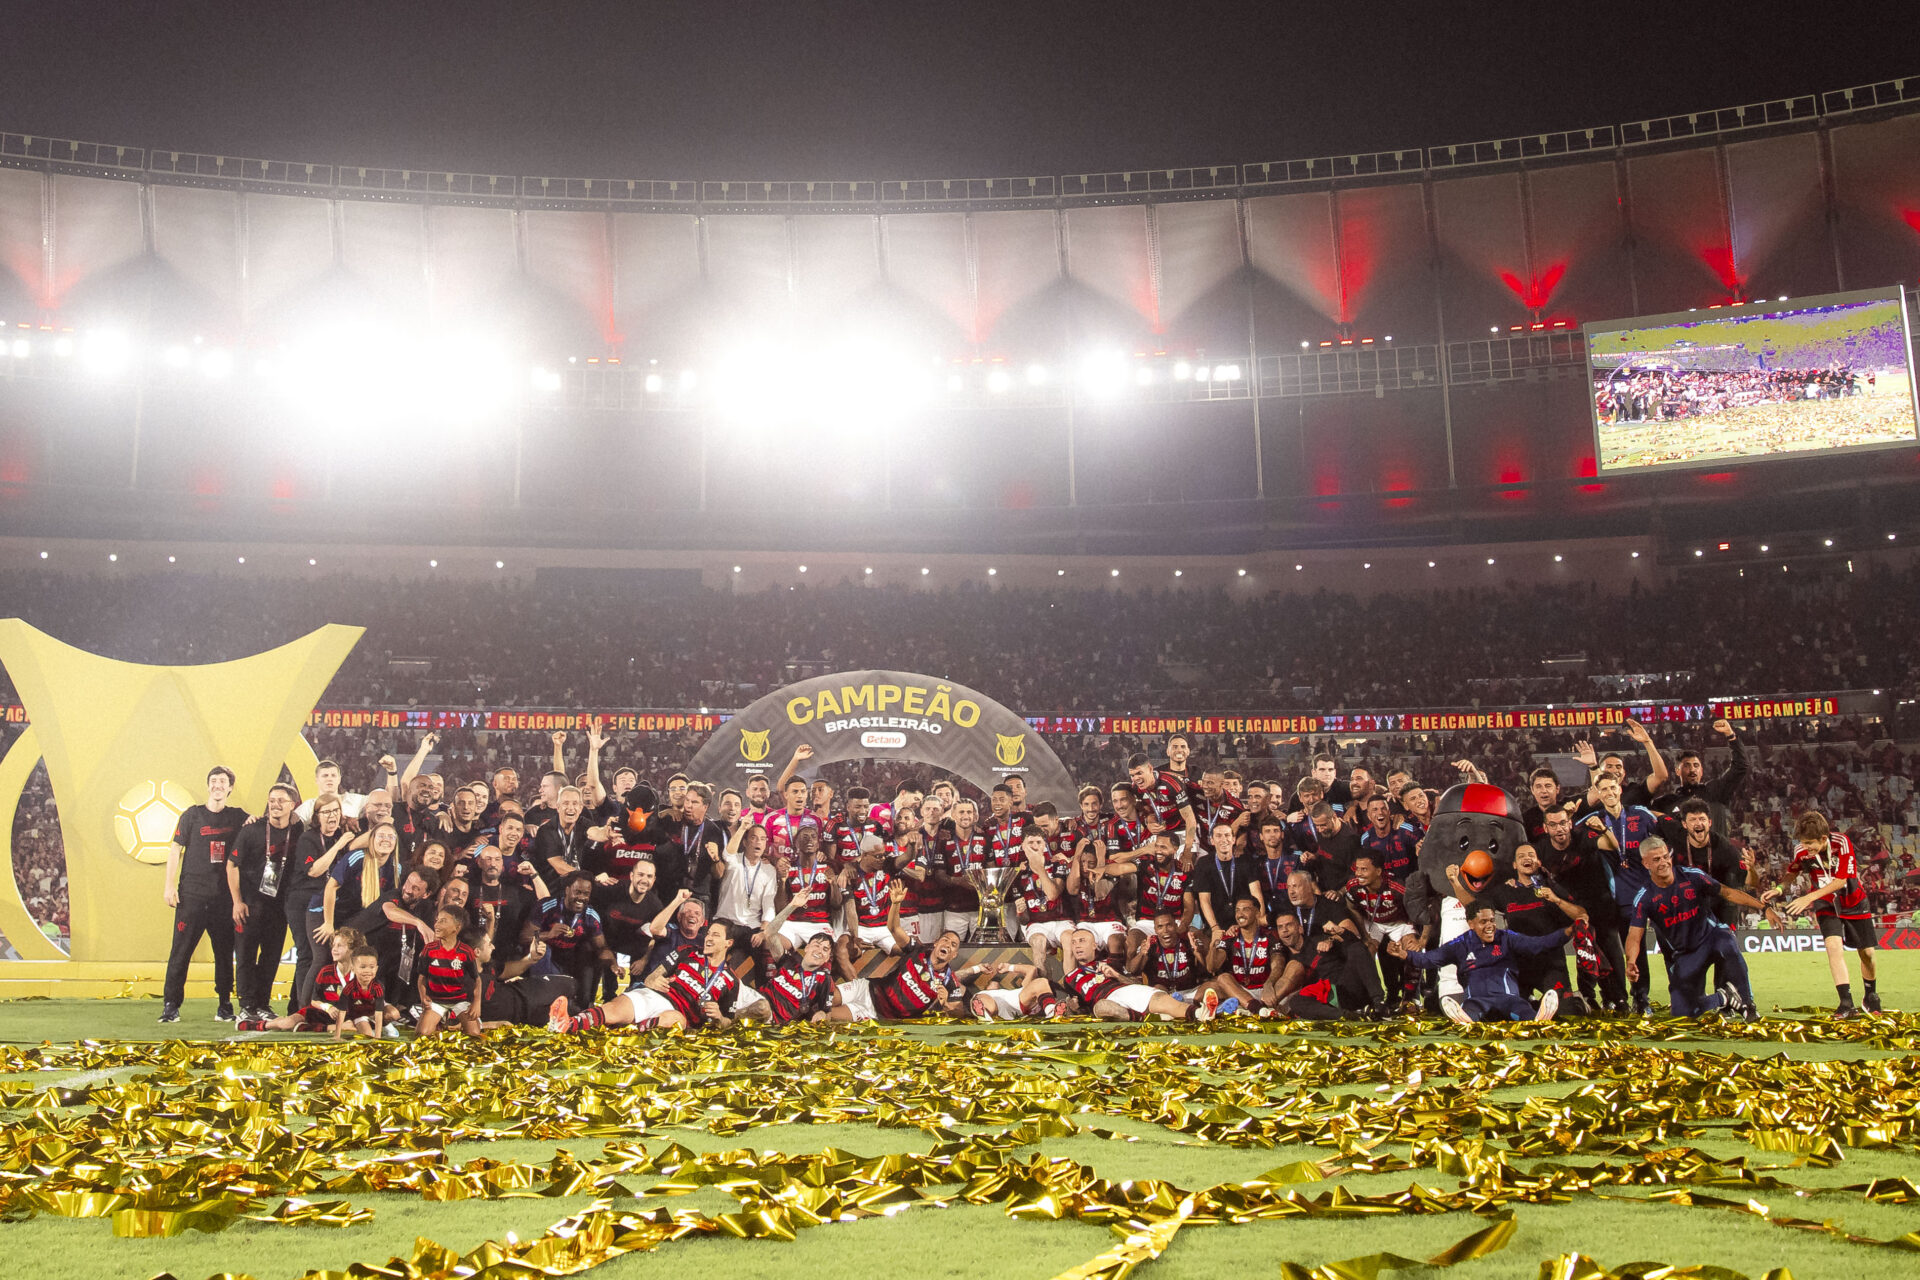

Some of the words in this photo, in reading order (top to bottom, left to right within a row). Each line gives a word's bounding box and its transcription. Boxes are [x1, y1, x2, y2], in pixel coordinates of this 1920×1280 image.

[786, 684, 981, 728] CAMPEÃO
[1724, 699, 1833, 719] ENEACAMPEÃO
[824, 716, 942, 735] BRASILEIRÃO
[1219, 716, 1317, 733] ENEACAMPEÃO
[1412, 712, 1513, 730] ENEACAMPEÃO
[1520, 709, 1624, 727] ENEACAMPEÃO
[866, 735, 901, 745] Betano
[615, 849, 653, 860] Betano
[994, 845, 1023, 858] Beano
[1744, 934, 1826, 953] CAMPE
[901, 971, 931, 1004] Betano
